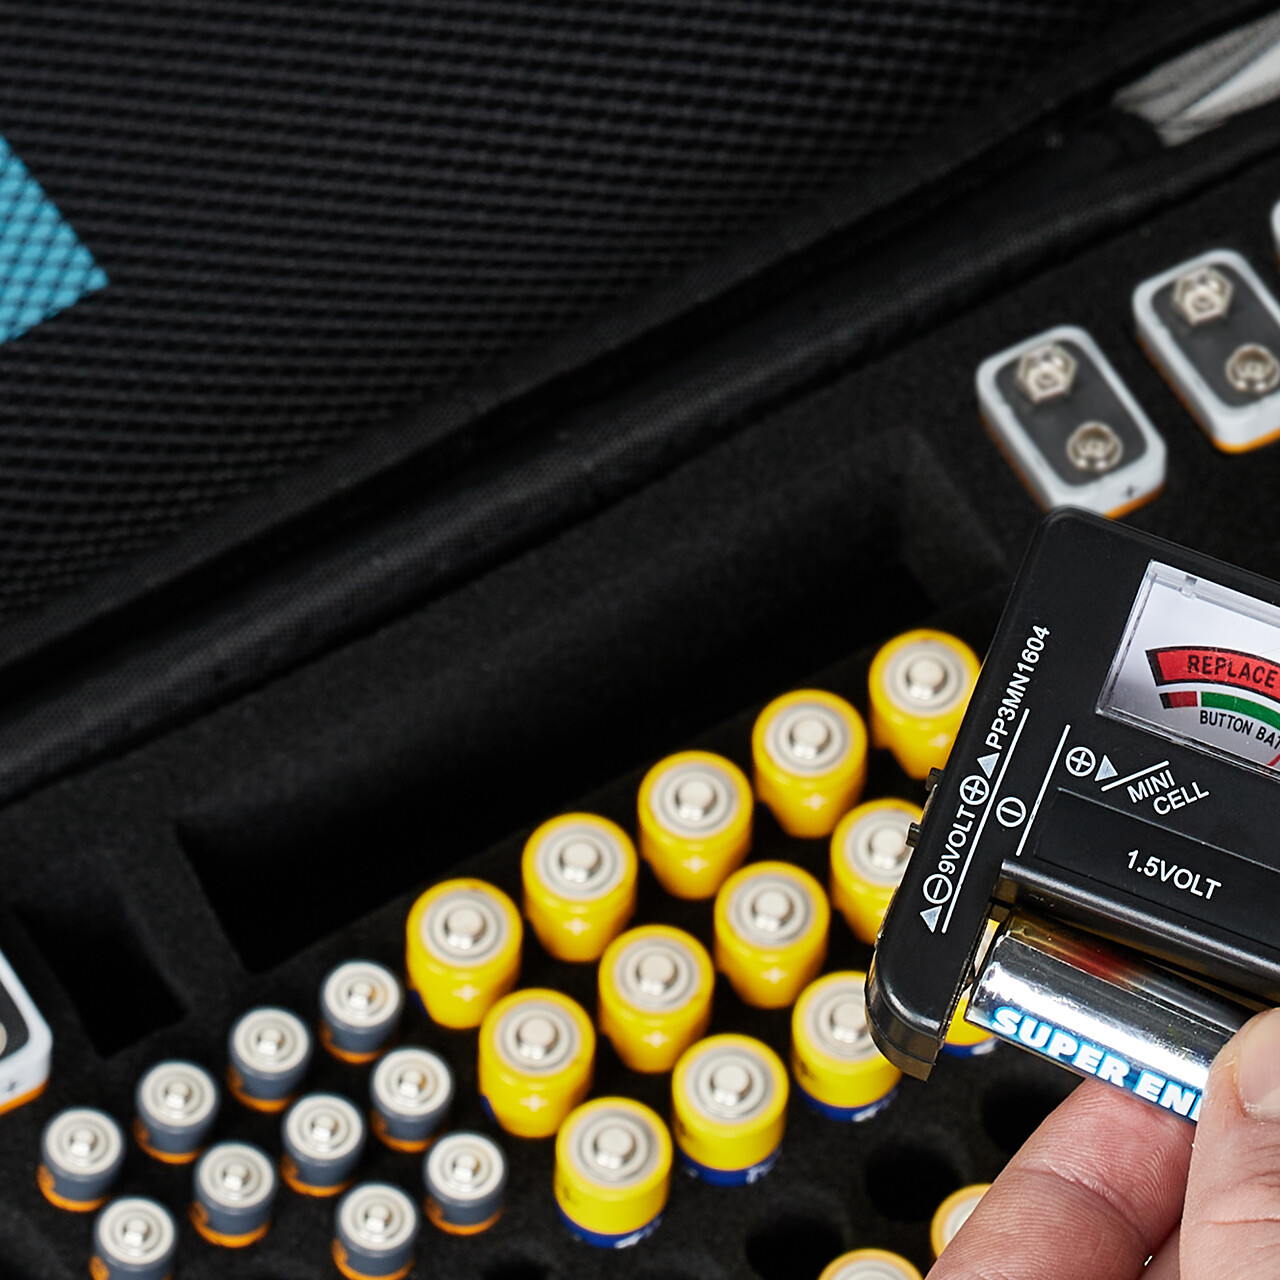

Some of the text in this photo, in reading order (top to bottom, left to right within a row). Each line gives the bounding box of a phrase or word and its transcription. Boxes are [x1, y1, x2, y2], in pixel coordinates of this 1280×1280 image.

[1186, 654, 1279, 689] REPLACE
[1199, 710, 1253, 736] BUTTON
[1127, 769, 1176, 803] MINI
[1153, 781, 1210, 815] CELL
[937, 803, 976, 875] 9VOLT
[1127, 849, 1222, 900] 1.5VOLT
[993, 1006, 1130, 1088] SUPER
